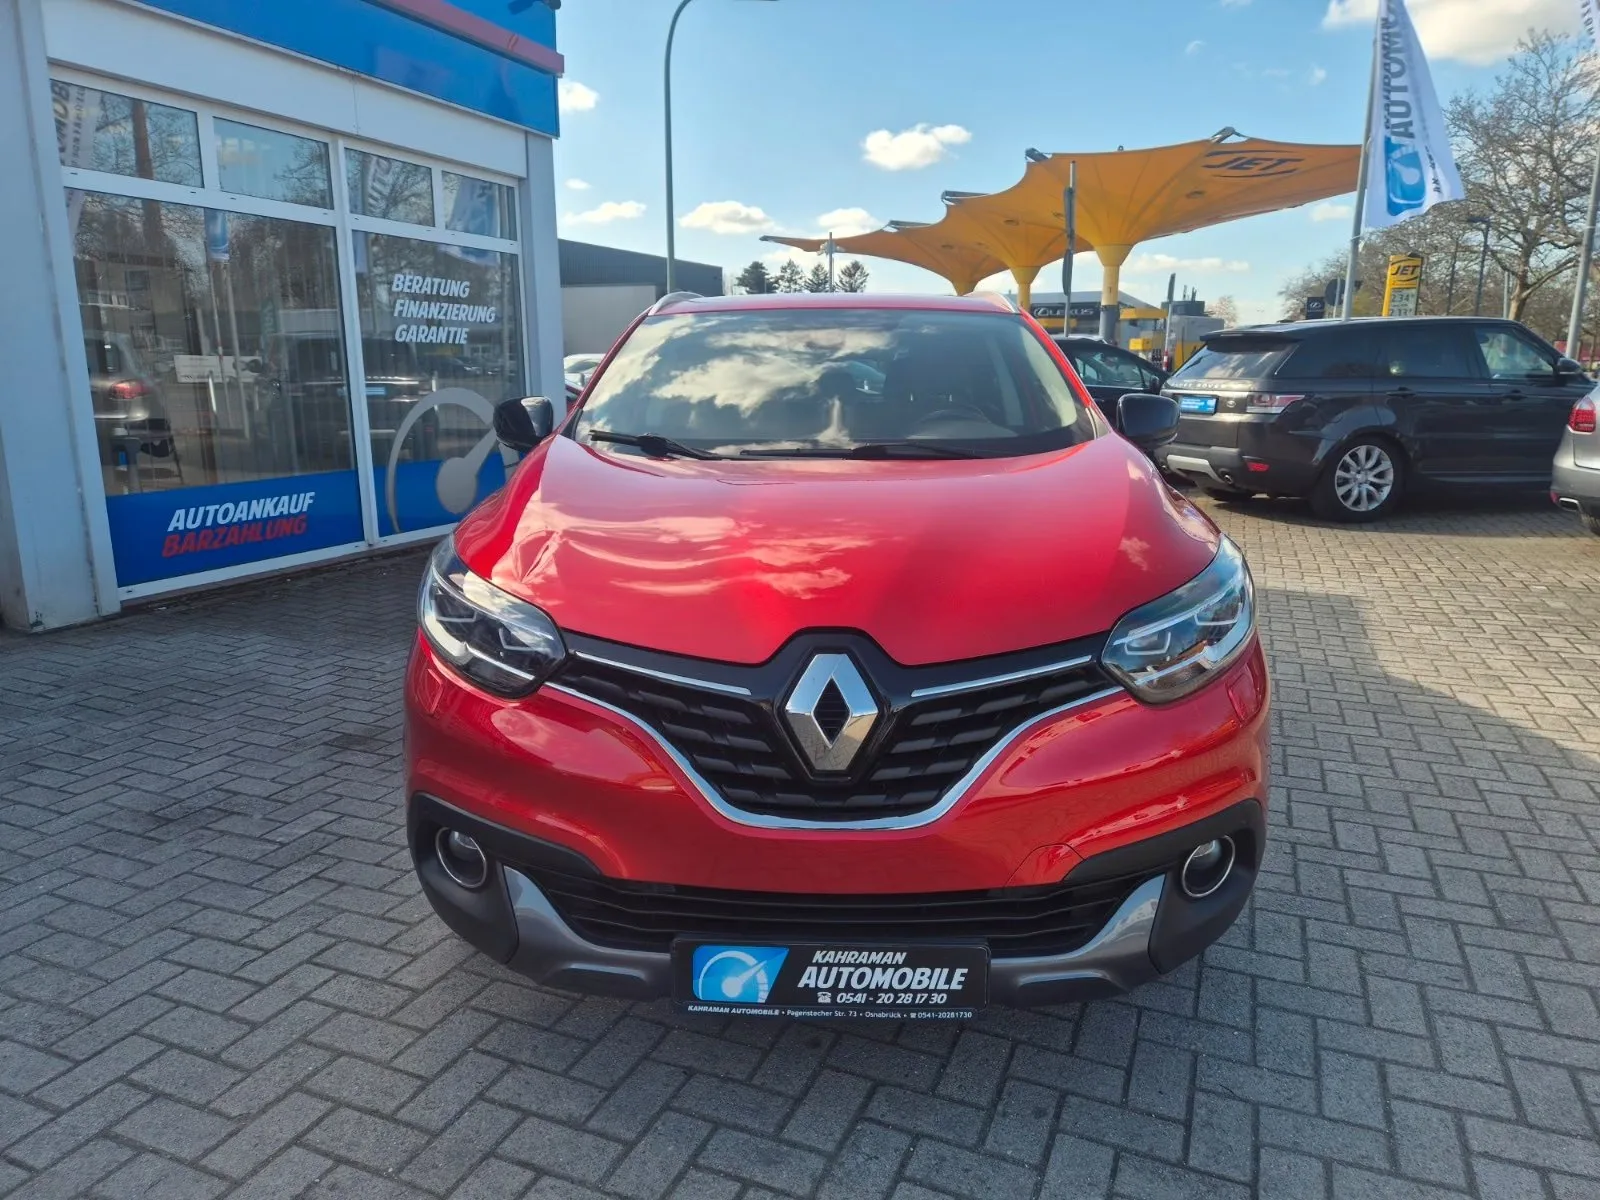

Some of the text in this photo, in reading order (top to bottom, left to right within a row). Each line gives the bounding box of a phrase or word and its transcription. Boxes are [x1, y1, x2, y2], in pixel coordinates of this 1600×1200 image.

[1201, 157, 1306, 171] JET
[1391, 265, 1421, 276] JET
[392, 273, 471, 299] BERATUNG
[393, 299, 497, 323] FINANZIERUNG
[394, 324, 470, 345] GARANTIE
[167, 491, 316, 532] AUTOANKAUF
[162, 513, 308, 558] BARZAHLUNG
[812, 950, 907, 965] KAHRAMAN
[797, 966, 969, 990] AUTOMOBILE
[836, 993, 867, 1004] 0541
[876, 993, 895, 1004] 20
[896, 993, 914, 1004] 28
[915, 994, 928, 1004] 17
[929, 994, 948, 1004] 30
[688, 1005, 730, 1014] KAHRAMAN
[731, 1007, 780, 1016] AUTOMOBILE
